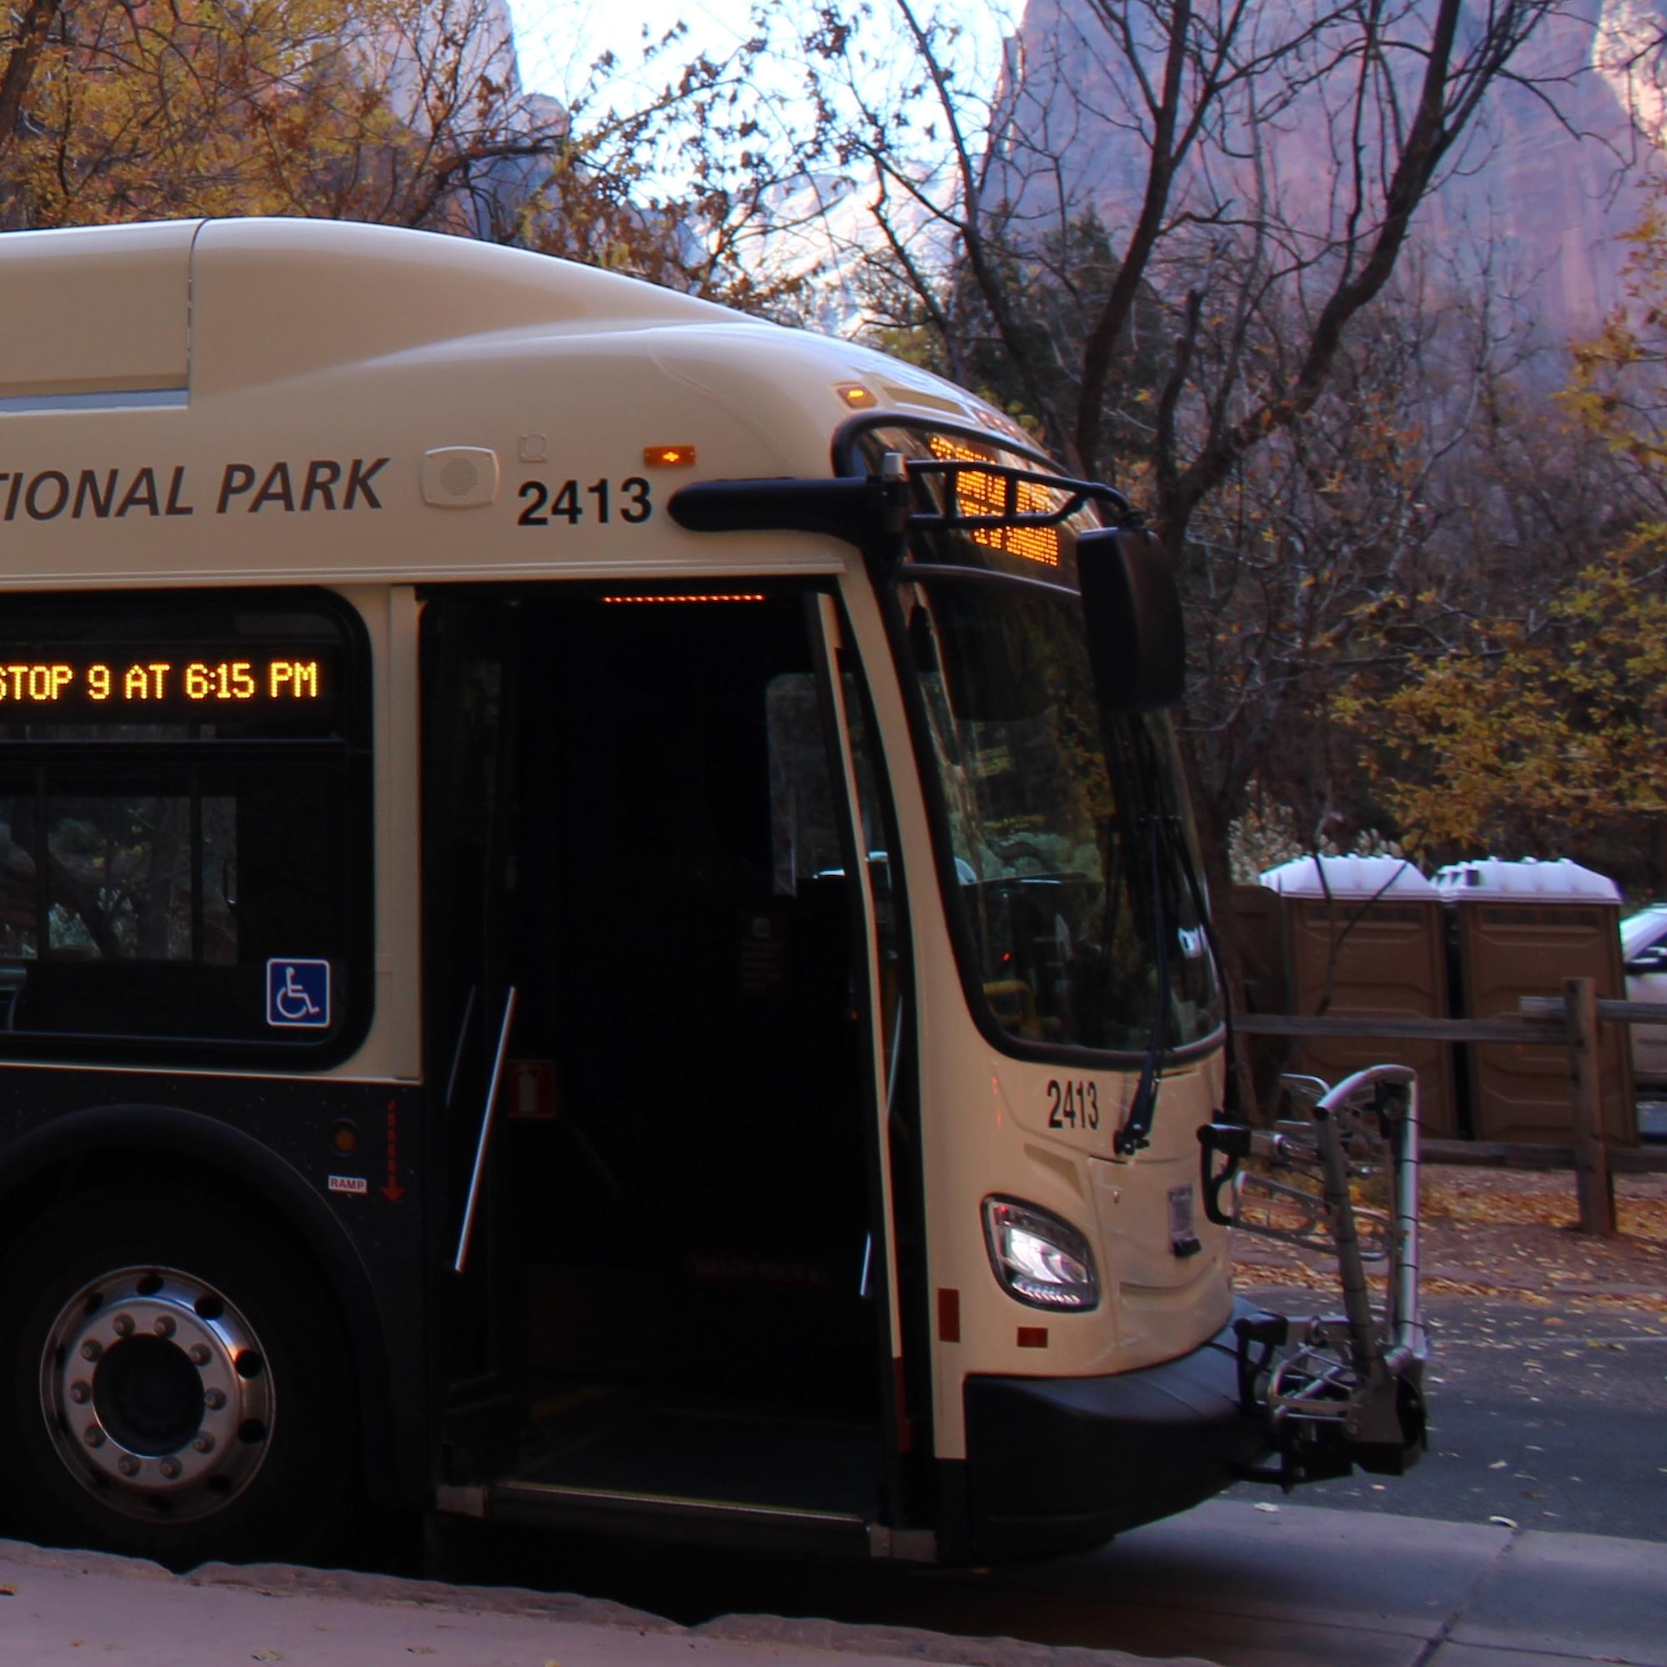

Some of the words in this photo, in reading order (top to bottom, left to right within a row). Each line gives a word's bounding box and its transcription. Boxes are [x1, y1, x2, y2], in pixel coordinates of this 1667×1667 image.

[216, 457, 391, 514] PARK
[517, 476, 652, 526] 2413
[88, 664, 110, 700] 9
[125, 664, 171, 700] AT
[185, 663, 255, 699] 6:15
[270, 661, 317, 698] PM
[1047, 1079, 1099, 1130] 2413
[330, 1177, 365, 1190] RAMP
